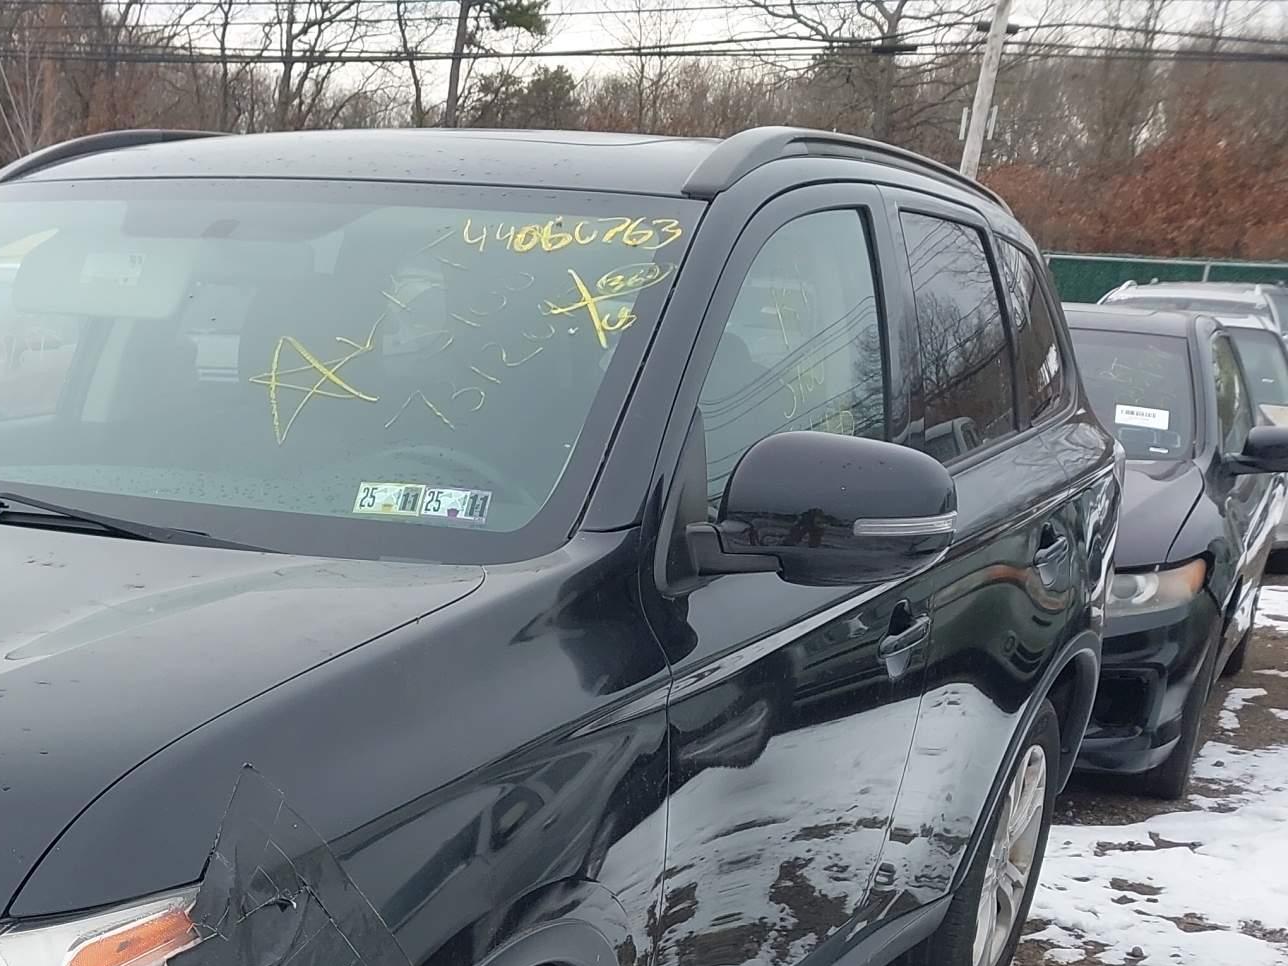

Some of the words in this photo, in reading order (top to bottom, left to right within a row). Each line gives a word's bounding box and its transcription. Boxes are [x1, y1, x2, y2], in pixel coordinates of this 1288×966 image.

[359, 486, 378, 508] 25
[399, 492, 419, 511] 11
[424, 490, 444, 513] 25
[467, 494, 489, 517] 11
